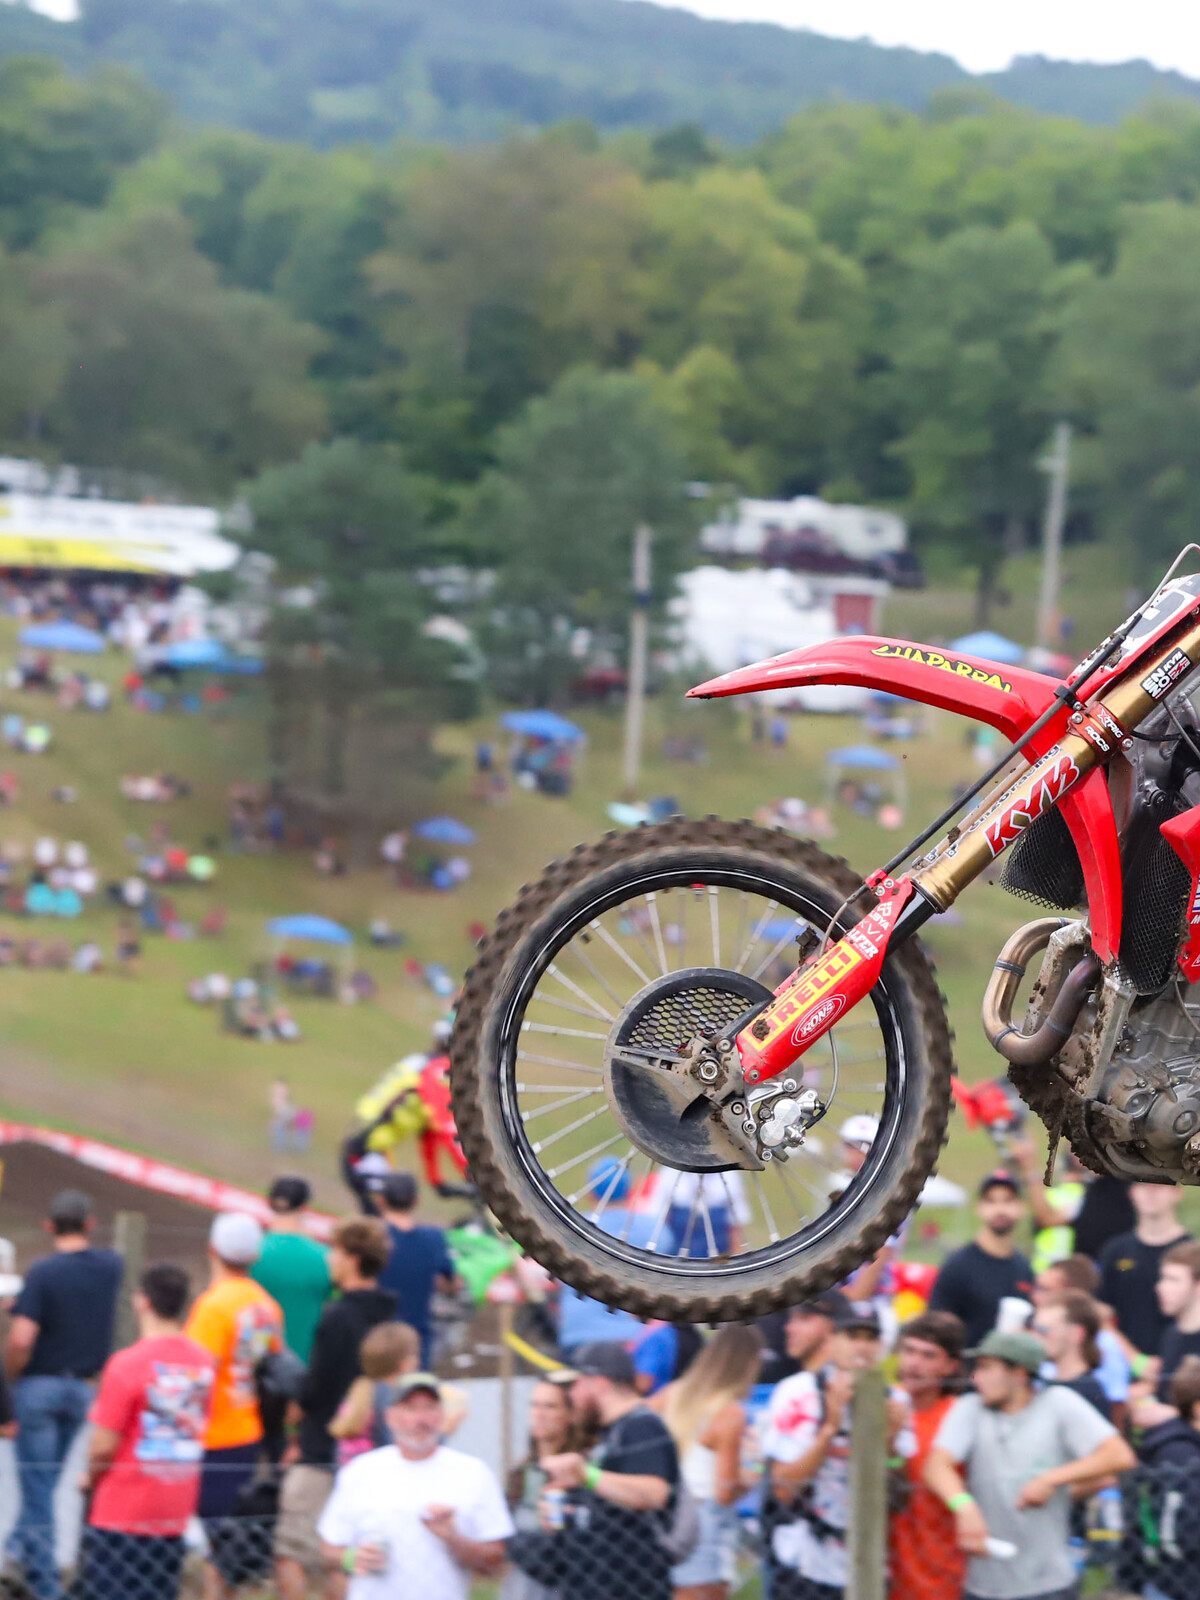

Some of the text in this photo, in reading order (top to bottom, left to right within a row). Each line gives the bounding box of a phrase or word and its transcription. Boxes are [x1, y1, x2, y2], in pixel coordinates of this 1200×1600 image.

[1084, 726, 1110, 752] ROCS
[1097, 708, 1124, 739] XTRIG
[983, 753, 1080, 858] KYB
